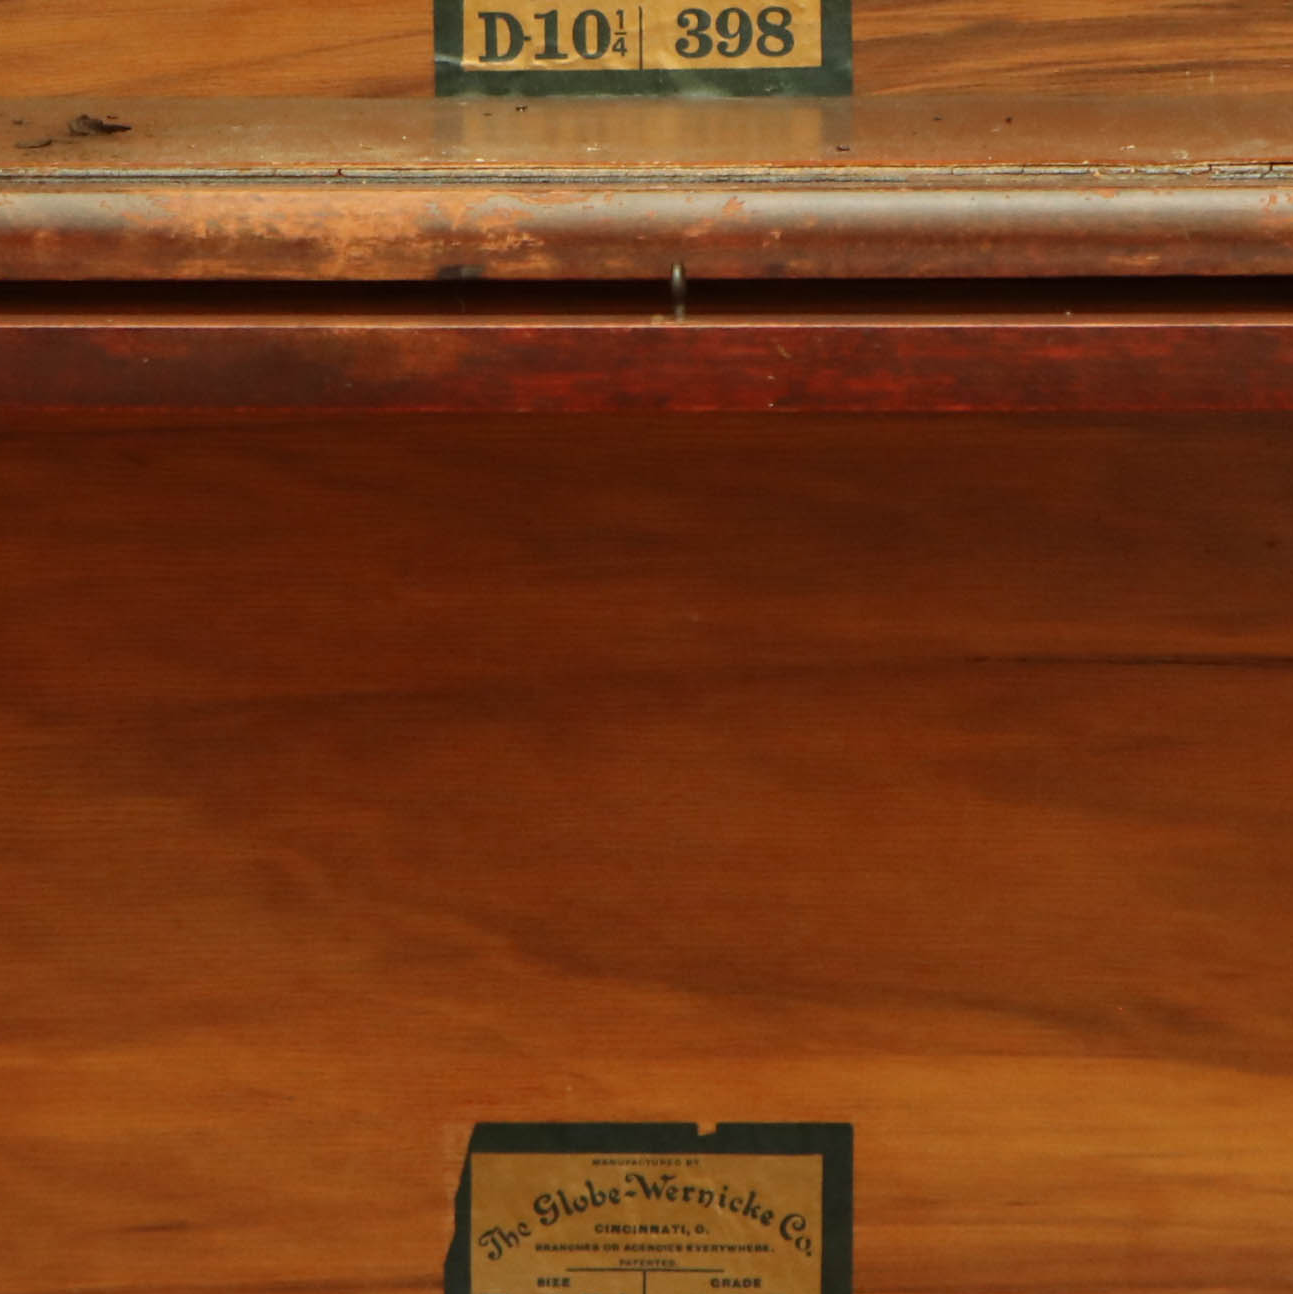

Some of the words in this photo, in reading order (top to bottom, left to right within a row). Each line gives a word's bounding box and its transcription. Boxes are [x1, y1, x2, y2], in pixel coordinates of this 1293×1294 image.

[675, 7, 795, 59] 398
[478, 1221, 532, 1262] The
[533, 1172, 775, 1227] Globe-Wernicke
[779, 1212, 813, 1258] Co.
[594, 1223, 691, 1236] CINCINNATI,
[537, 1277, 571, 1288] SIZE
[710, 1278, 763, 1289] GRADE
